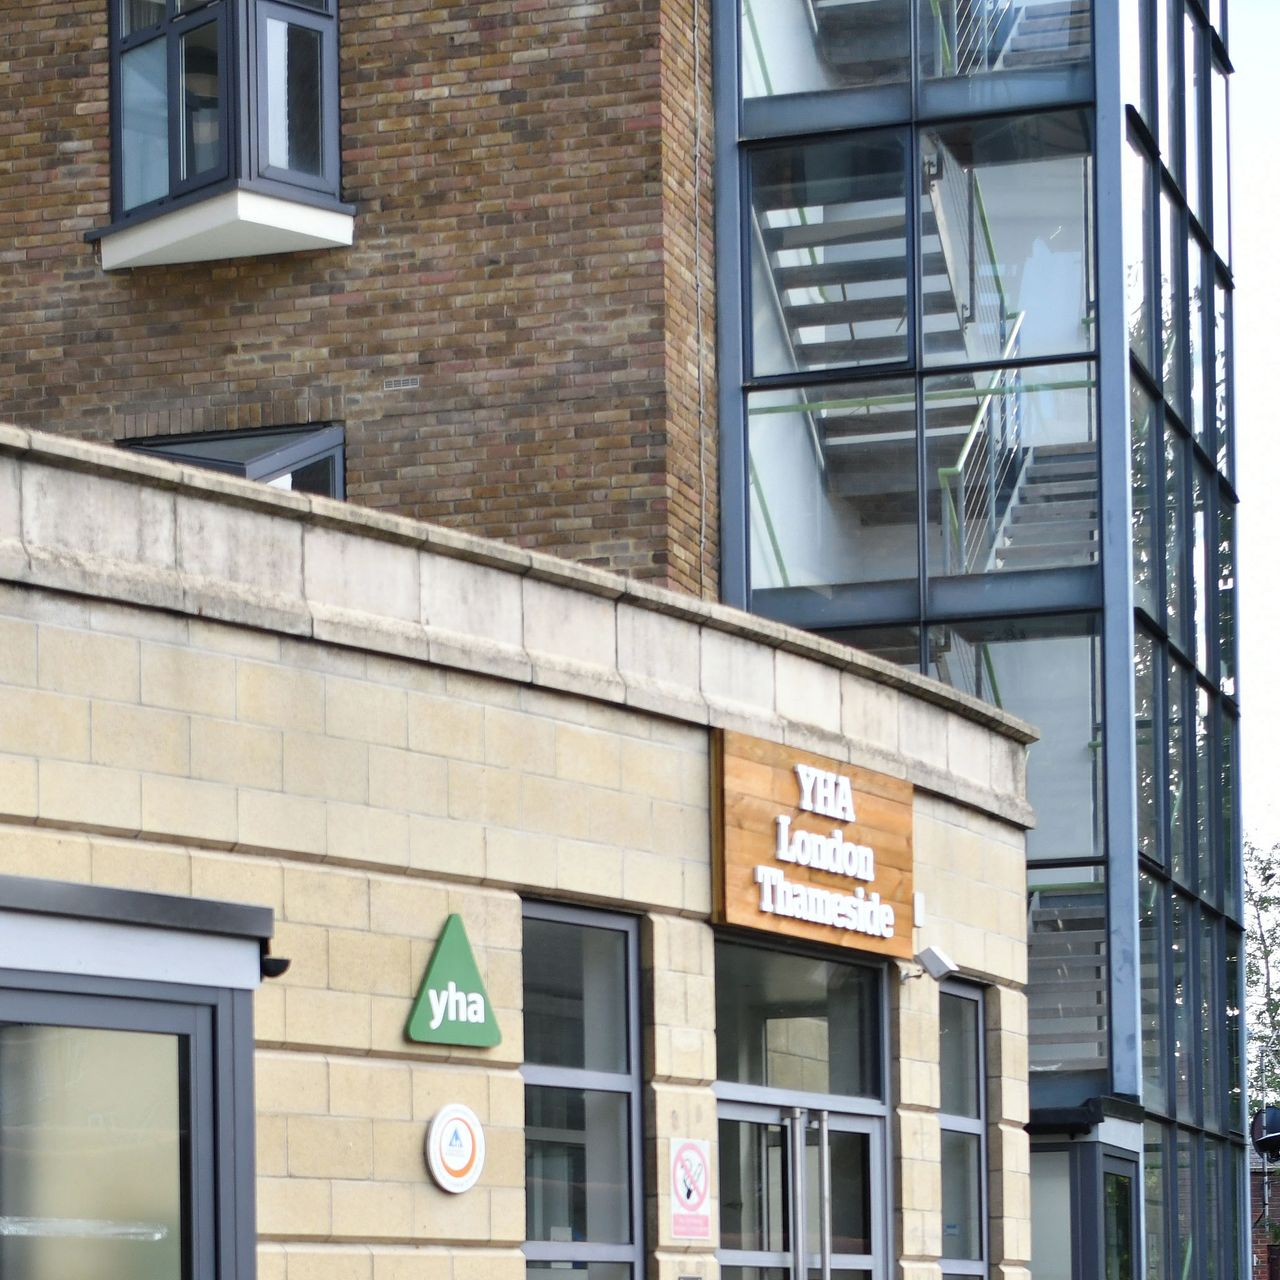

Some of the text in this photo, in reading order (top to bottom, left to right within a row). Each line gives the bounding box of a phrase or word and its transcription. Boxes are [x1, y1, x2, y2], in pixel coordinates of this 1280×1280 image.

[794, 763, 856, 823] YHA
[776, 815, 875, 882] London
[753, 864, 895, 938] Thameside
[428, 981, 485, 1030] yha
